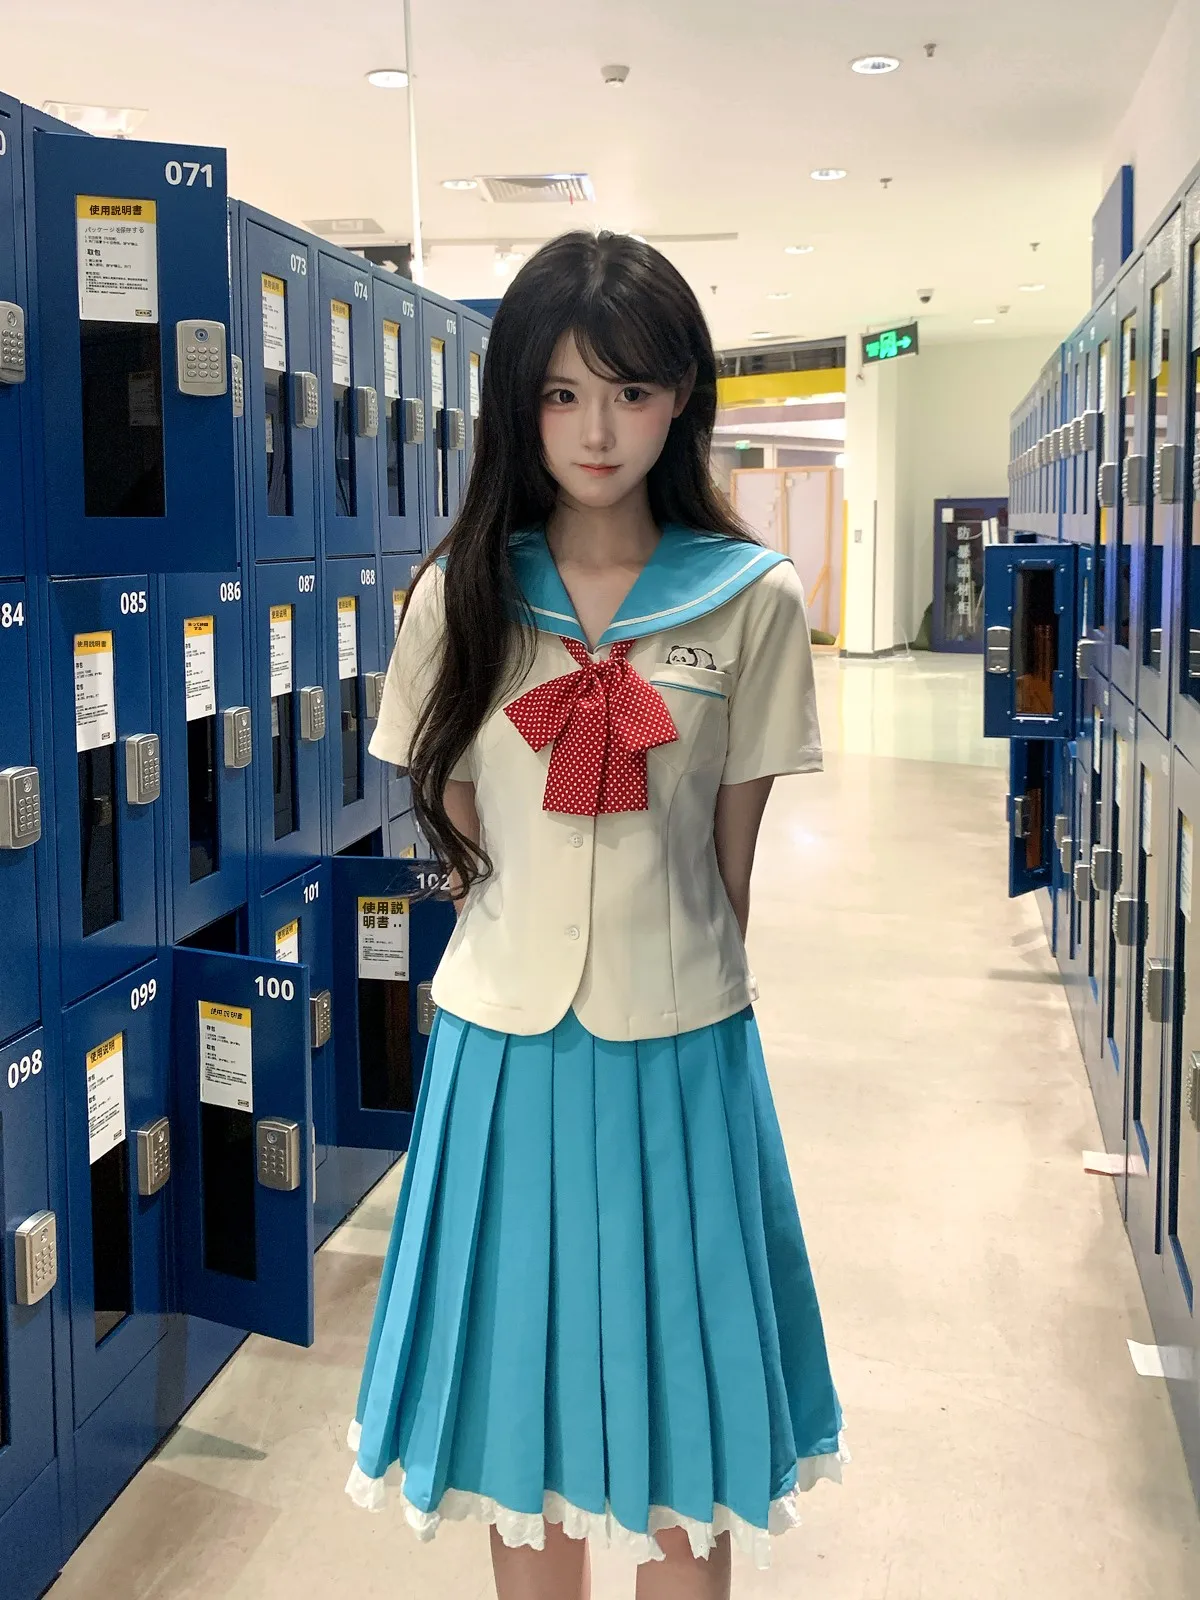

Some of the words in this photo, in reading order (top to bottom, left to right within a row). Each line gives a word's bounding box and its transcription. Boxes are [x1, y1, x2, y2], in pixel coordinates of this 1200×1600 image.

[165, 161, 213, 188] 071
[89, 205, 143, 216] 使用説明書
[290, 254, 307, 276] 073
[354, 281, 369, 301] 074
[402, 301, 415, 318] 075
[446, 319, 457, 335] 076
[298, 575, 315, 593] 087
[361, 569, 376, 585] 088
[220, 581, 241, 602] 086
[120, 591, 147, 615] 085
[416, 872, 451, 891] 102
[303, 881, 319, 903] 101
[362, 901, 404, 915] 使用説
[130, 978, 157, 1010] 099
[254, 975, 295, 1001] 100
[7, 1049, 43, 1089] 098
